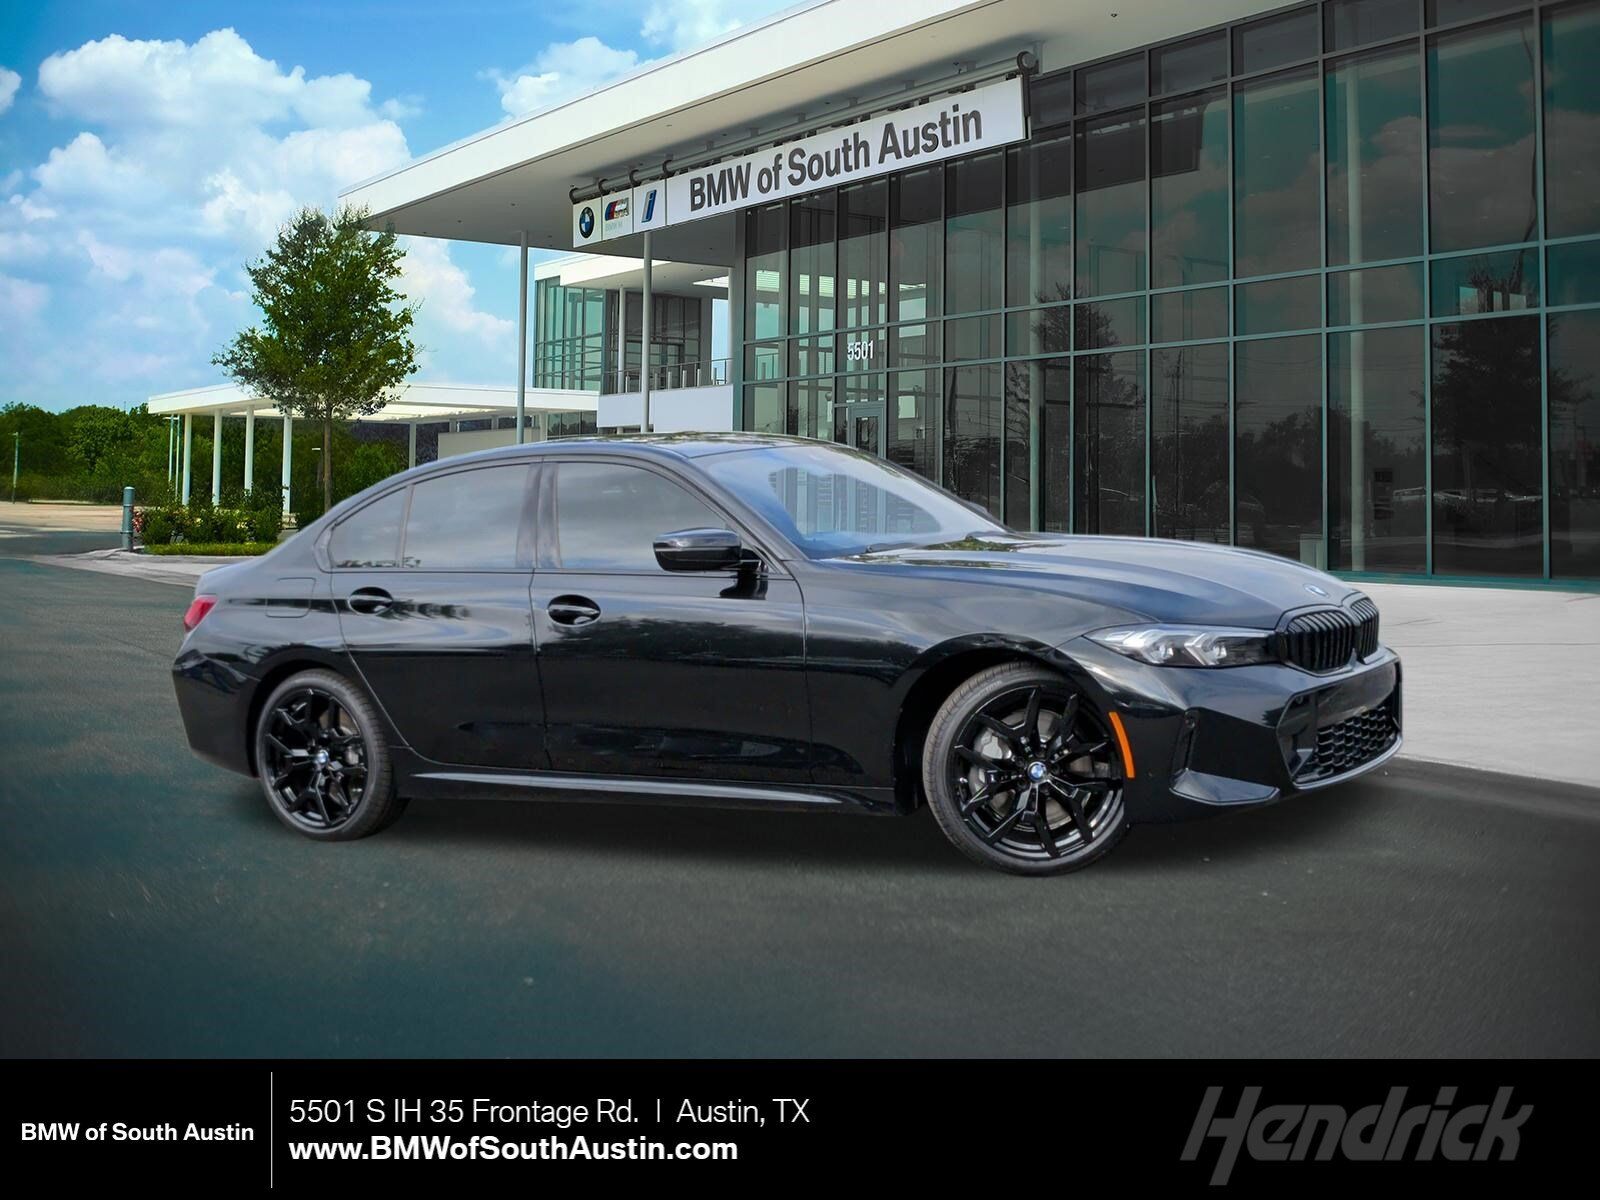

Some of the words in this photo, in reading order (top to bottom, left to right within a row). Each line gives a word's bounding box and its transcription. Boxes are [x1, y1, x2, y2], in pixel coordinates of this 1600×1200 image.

[689, 161, 752, 212] BMW
[757, 153, 783, 194] of
[787, 131, 870, 186] South
[878, 103, 982, 164] Austin
[847, 340, 874, 360] 5501
